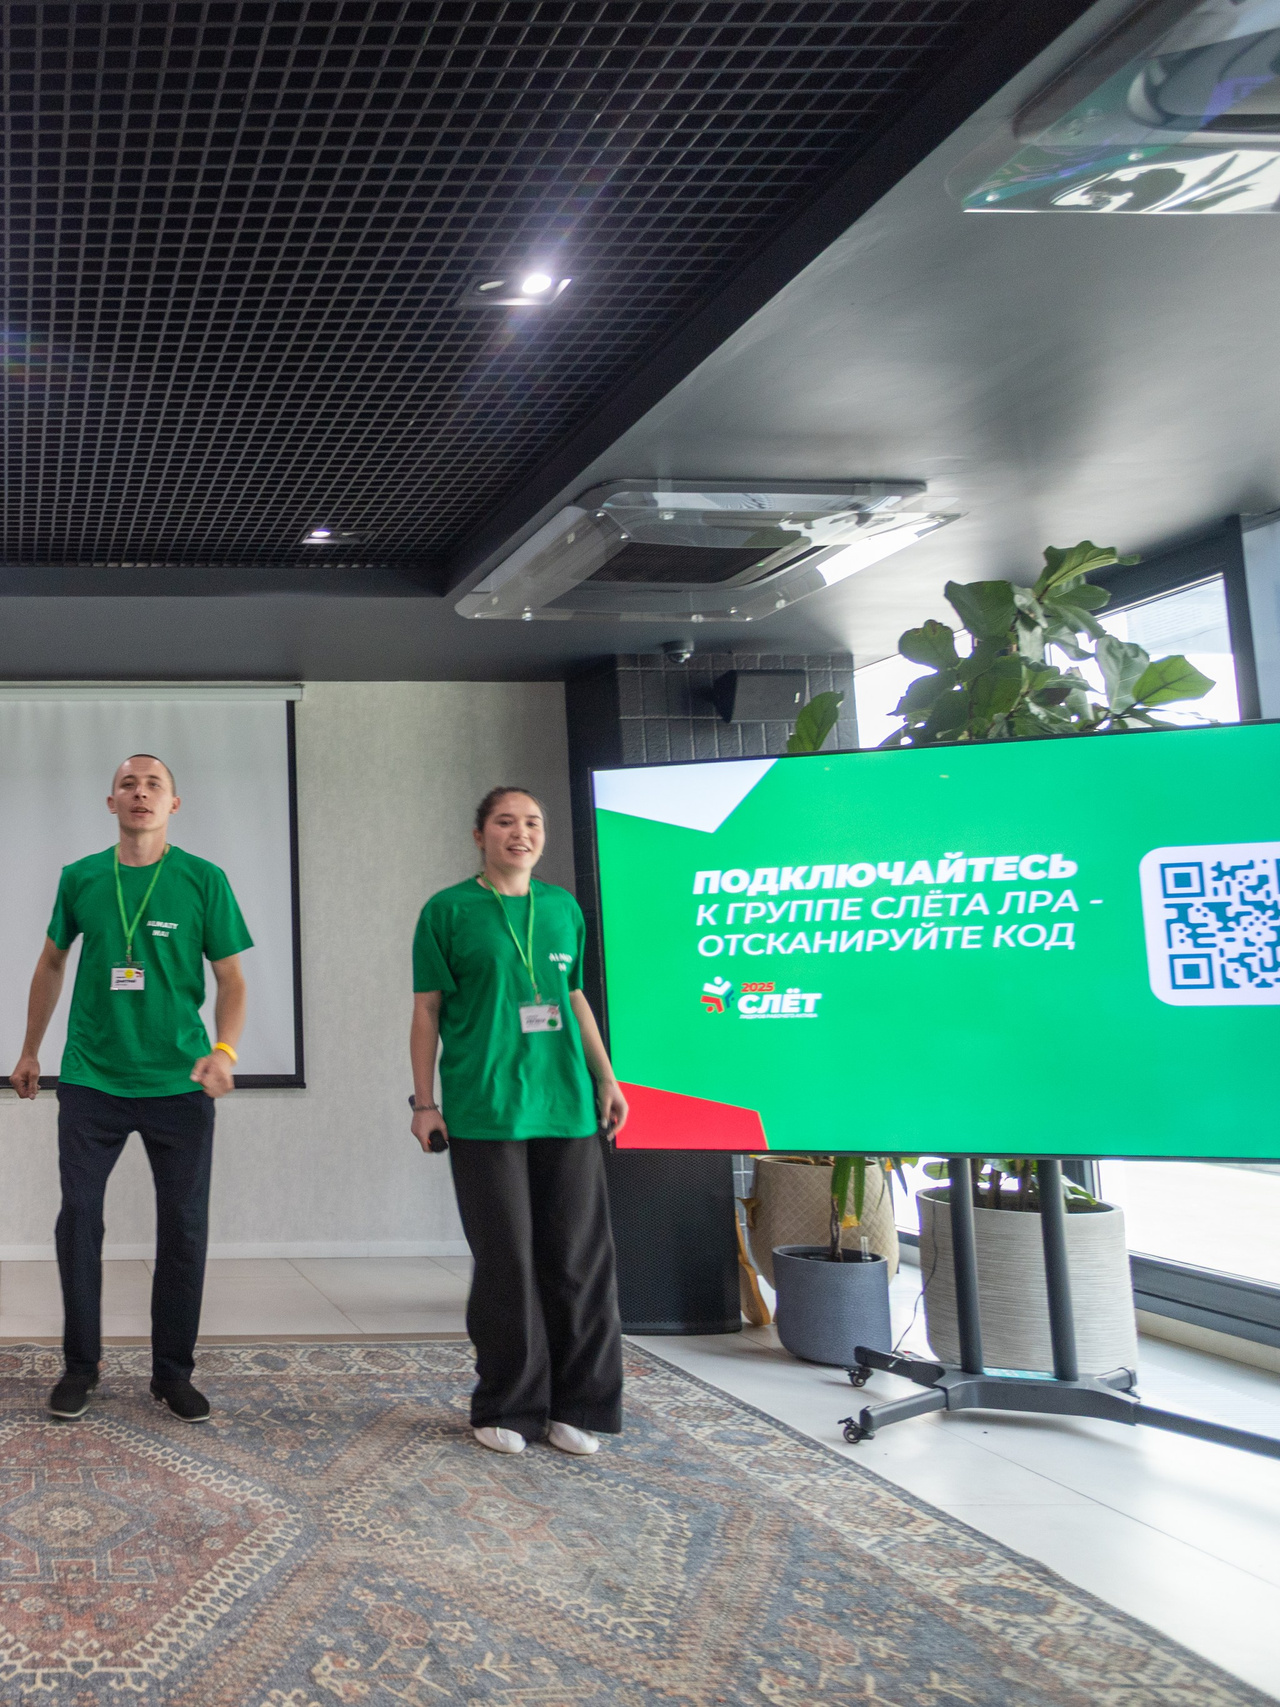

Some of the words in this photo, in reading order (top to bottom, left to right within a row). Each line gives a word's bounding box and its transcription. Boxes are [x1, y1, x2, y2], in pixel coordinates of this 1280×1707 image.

[693, 851, 1078, 896] ПОДКЛЮЧАЙТЕСЬ
[696, 903, 719, 926] К
[726, 897, 863, 925] ГРУППЕ
[871, 889, 990, 920] СЛЁТА
[997, 889, 1080, 915] ЛРА
[697, 922, 984, 957] ОТСКАНИРУЙТЕ
[992, 922, 1076, 951] КОД
[737, 987, 823, 1014] СЛЁТ
[741, 982, 776, 993] 2025
